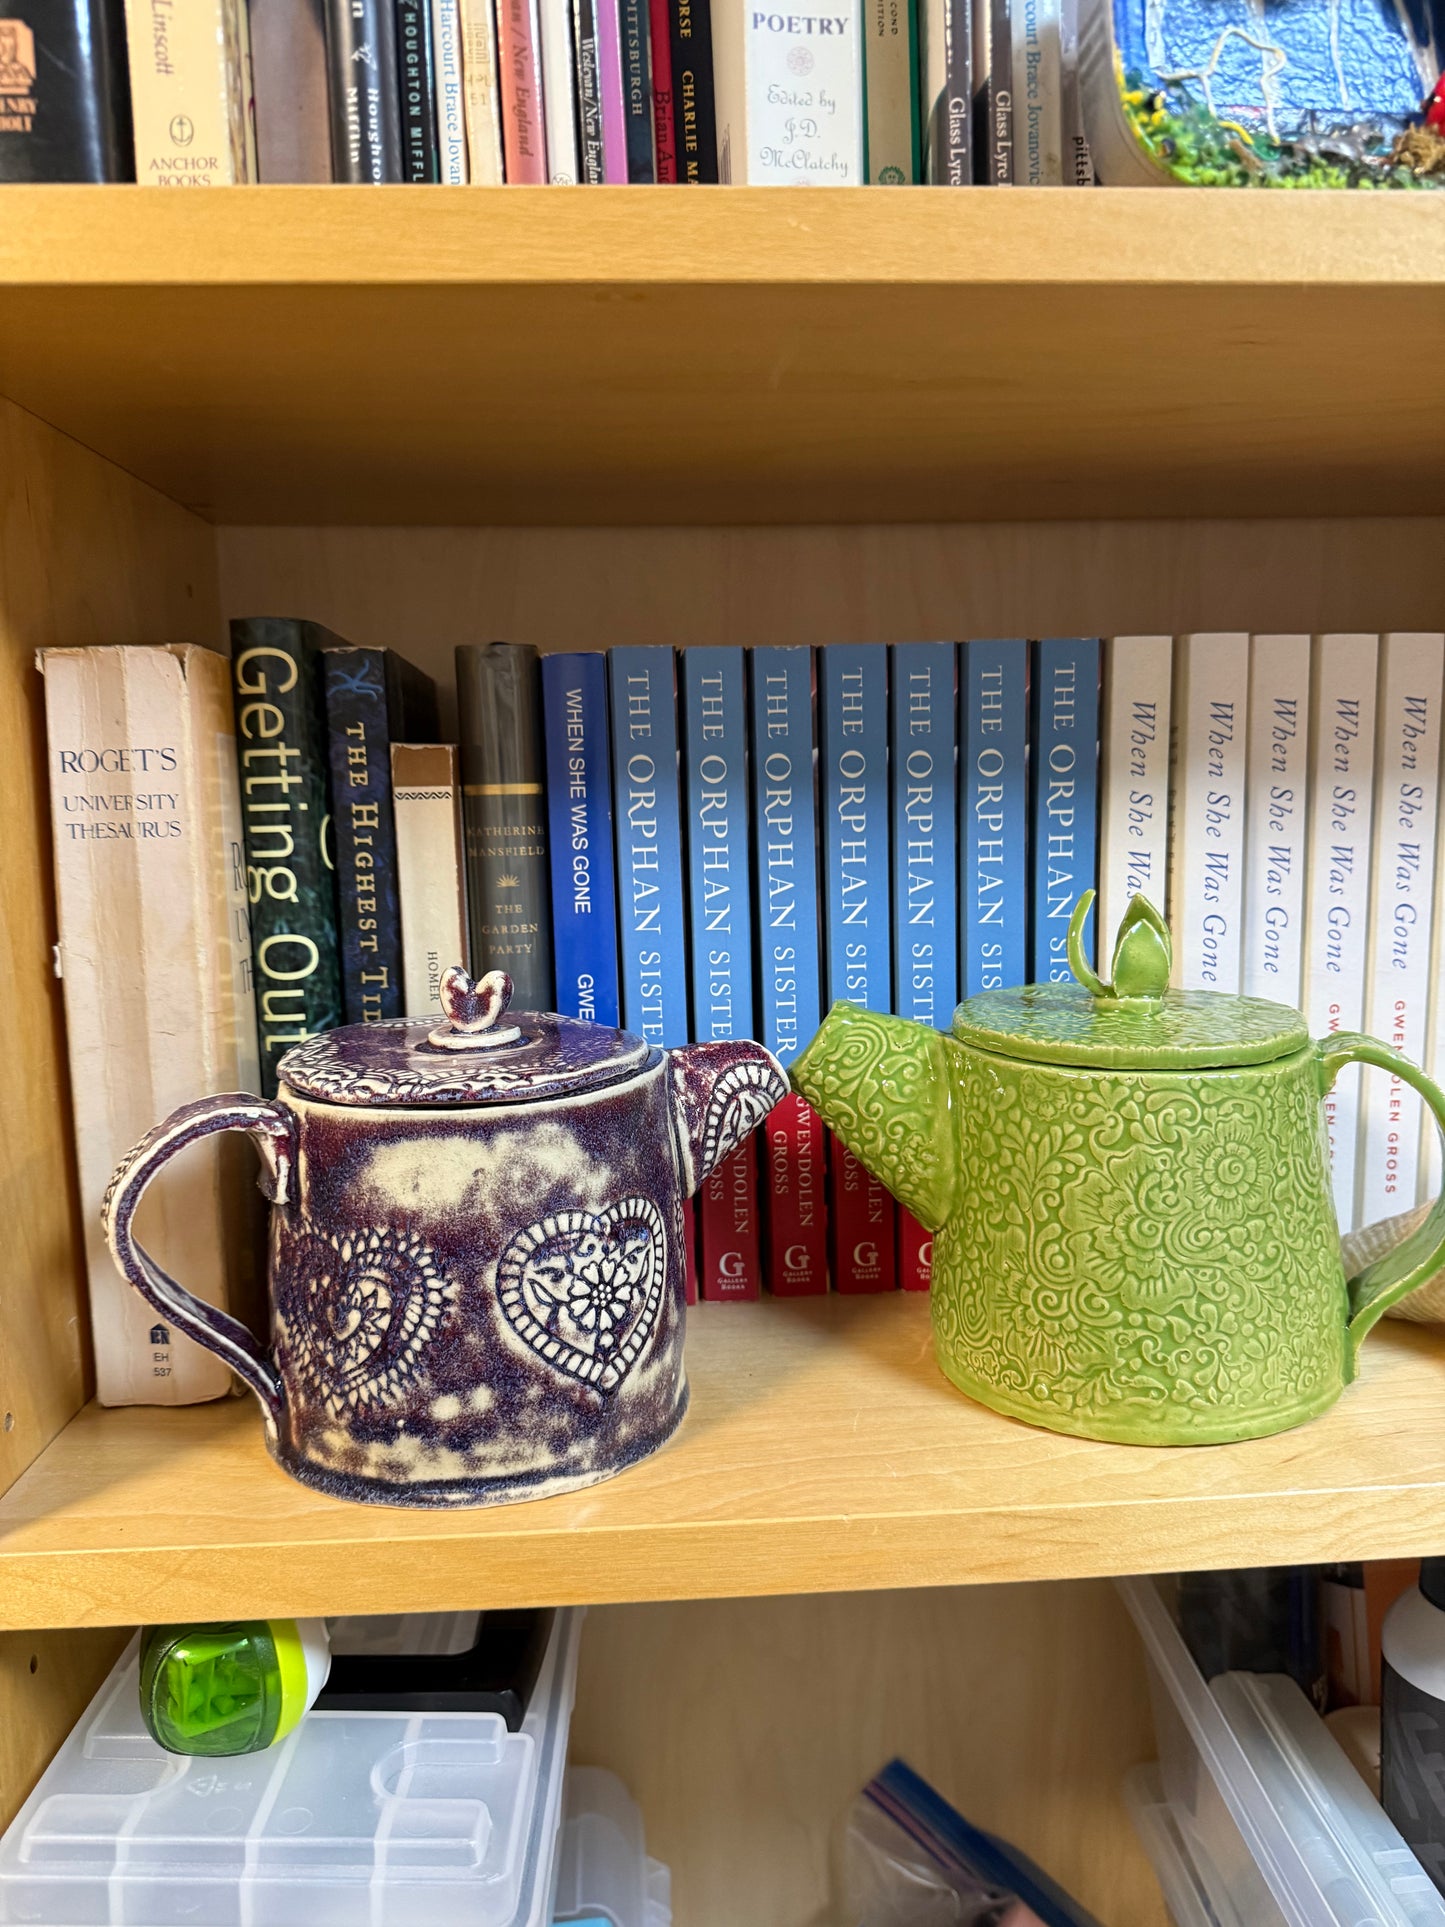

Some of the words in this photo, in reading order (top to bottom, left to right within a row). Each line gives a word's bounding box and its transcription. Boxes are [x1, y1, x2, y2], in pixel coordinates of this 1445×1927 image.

[152, 0, 174, 75] Linscott
[440, 0, 456, 76] Harcourt
[752, 12, 849, 36] POETRY
[1025, 0, 1039, 45] court
[405, 13, 421, 116] HOUGHTON
[513, 45, 528, 80] New
[1025, 51, 1041, 99] Brace
[348, 87, 360, 163] Mifflin
[445, 83, 459, 131] Brace
[512, 87, 534, 157] England
[656, 90, 672, 143] Brian
[682, 70, 698, 152] CHARLIE
[767, 84, 813, 107] Edited
[819, 89, 836, 115] by
[949, 97, 967, 145] Glass
[995, 91, 1012, 138] Glass
[149, 157, 218, 170] ANCHOR
[410, 127, 424, 182] MIFFL
[760, 147, 848, 178] McClatchy
[950, 148, 967, 185] Lyre
[997, 140, 1012, 178] Lyre
[1027, 103, 1044, 185] Jovanovic
[158, 174, 211, 187] BOOKS
[566, 688, 585, 751] WHEN
[626, 670, 652, 741] THE
[701, 671, 724, 741] THE
[766, 670, 788, 739] THE
[841, 667, 864, 736] THE
[909, 667, 932, 736] THE
[981, 665, 1003, 735] THE
[1053, 662, 1076, 732] THE
[60, 748, 178, 773] ROGET'S
[346, 722, 369, 788] THE
[1130, 701, 1156, 777] When
[1208, 701, 1234, 777] When
[1271, 697, 1297, 773] When
[1335, 698, 1360, 773] When
[1401, 696, 1428, 770] When
[63, 793, 180, 813] UNIVERSITY
[236, 646, 309, 904] Getting
[569, 758, 586, 799] SHE
[1398, 783, 1423, 829] She
[65, 820, 183, 840] THESAURUS
[570, 804, 589, 850] WAS
[764, 752, 796, 931] ORPHAN
[838, 749, 868, 928] ORPHAN
[905, 749, 935, 928] ORPHAN
[975, 748, 1005, 927] ORPHAN
[1047, 744, 1077, 920] ORPHAN
[1128, 790, 1154, 837] She
[1206, 790, 1231, 838] She
[1269, 786, 1294, 832] She
[1332, 786, 1357, 832] She
[469, 846, 545, 857] MANSFIELD
[627, 753, 662, 935] ORPHAN
[699, 755, 731, 935] ORPHAN
[1266, 845, 1292, 896] Was
[1329, 845, 1354, 896] Was
[1396, 842, 1421, 893] Was
[352, 801, 379, 954] HIGHEST
[496, 904, 523, 914] THE
[573, 855, 591, 914] GONE
[1204, 851, 1230, 903] Was
[482, 923, 539, 935] GARDEN
[489, 943, 533, 955] PARTY
[1202, 914, 1227, 983] Gone
[1264, 906, 1289, 974] Gone
[1327, 906, 1351, 974] Gone
[1392, 903, 1417, 970] Gone
[258, 933, 322, 1052] Out
[428, 950, 438, 1002] HOMER
[639, 950, 664, 1049] SISTE
[708, 950, 733, 1038] SISTE
[773, 946, 798, 1057] SISTER
[733, 1141, 749, 1234] NDOLEN
[773, 1130, 789, 1195] GROSS
[795, 1096, 814, 1228] GWENDOLEN
[1385, 1132, 1401, 1194] GROSS
[153, 1353, 169, 1362] EH
[153, 1368, 171, 1377] 537
